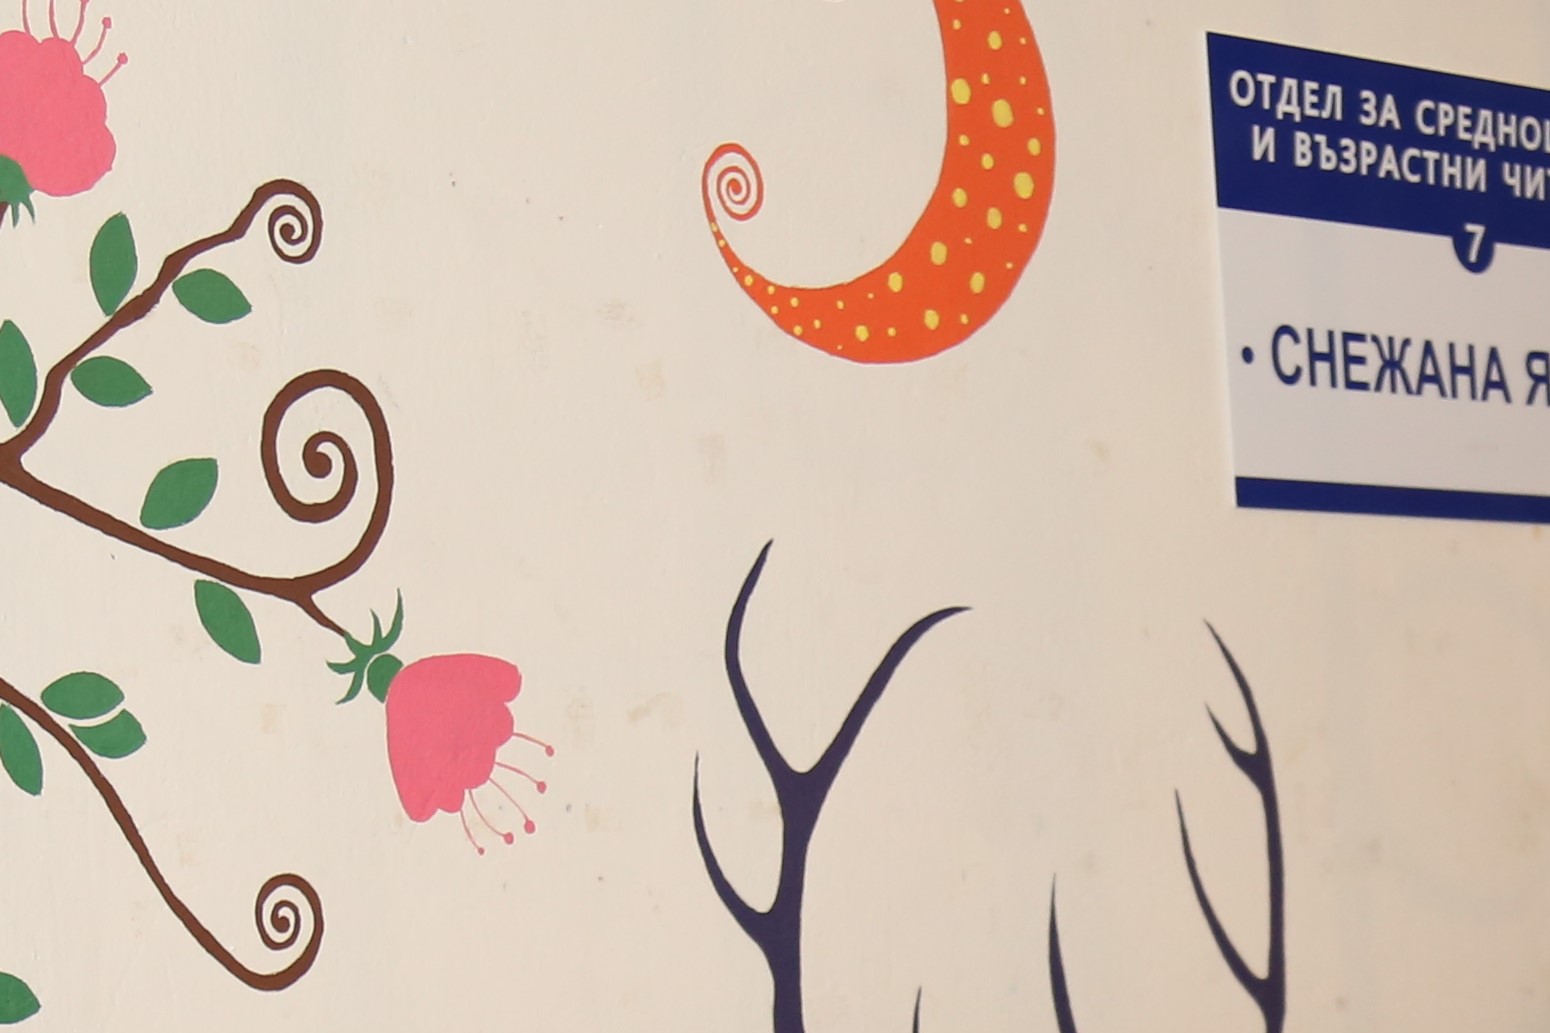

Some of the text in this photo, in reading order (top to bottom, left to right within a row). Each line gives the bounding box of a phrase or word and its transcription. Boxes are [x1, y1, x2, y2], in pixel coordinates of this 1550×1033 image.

[1229, 69, 1343, 121] ОТДЕЛ
[1359, 89, 1402, 131] ЗА
[1251, 125, 1276, 163] И
[1294, 131, 1487, 193] ВЪЗРАСТНИ
[1464, 223, 1486, 263] 7
[1271, 324, 1512, 405] СНЕЖАНА
